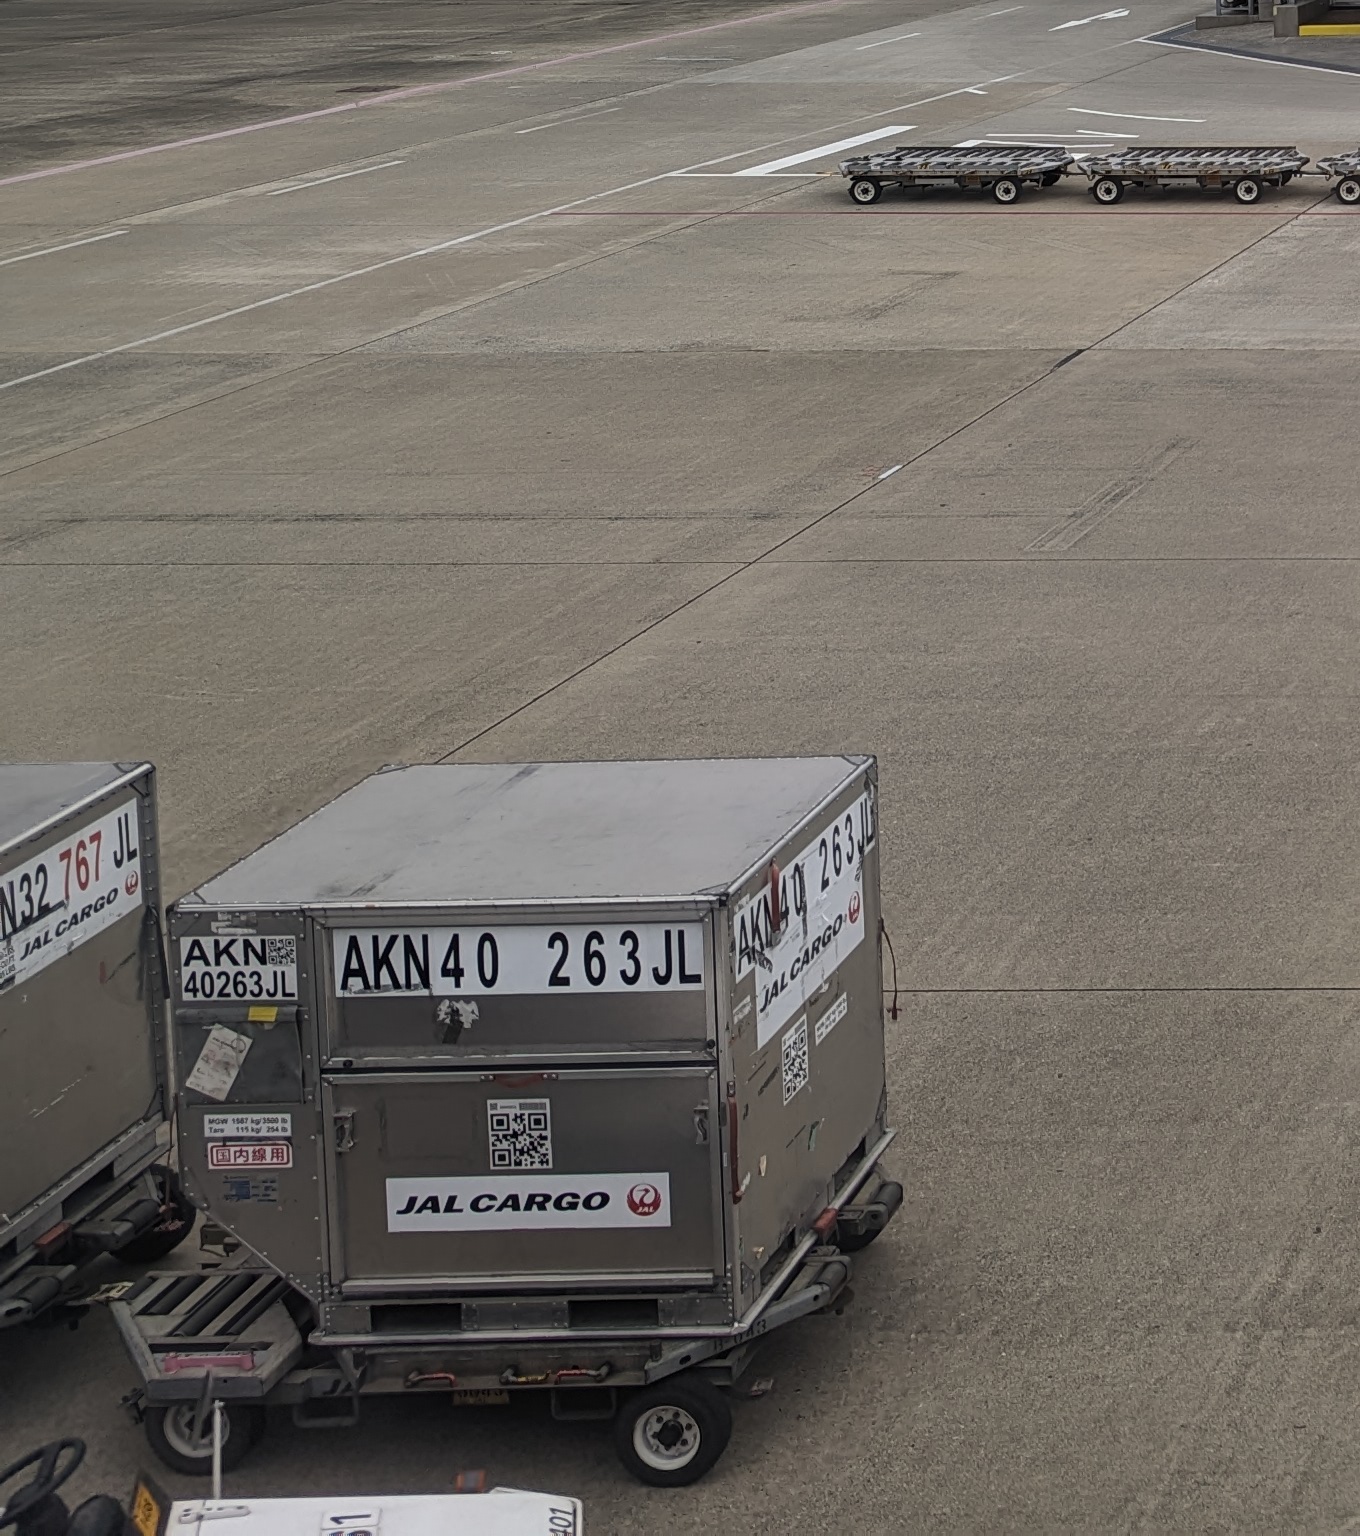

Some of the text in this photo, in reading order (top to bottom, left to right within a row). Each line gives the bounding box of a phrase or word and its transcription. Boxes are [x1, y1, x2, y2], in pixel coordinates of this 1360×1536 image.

[59, 830, 102, 902] 767
[113, 813, 138, 869] JL
[20, 887, 119, 961] JAL CARGO
[183, 938, 268, 967] AKN
[759, 977, 789, 1014] JAL
[789, 913, 843, 981] CARGO
[184, 970, 296, 999] 40263JL
[208, 1117, 229, 1125] MGW
[216, 1148, 285, 1164] 国内線用
[396, 1191, 610, 1215] JAL CARGO
